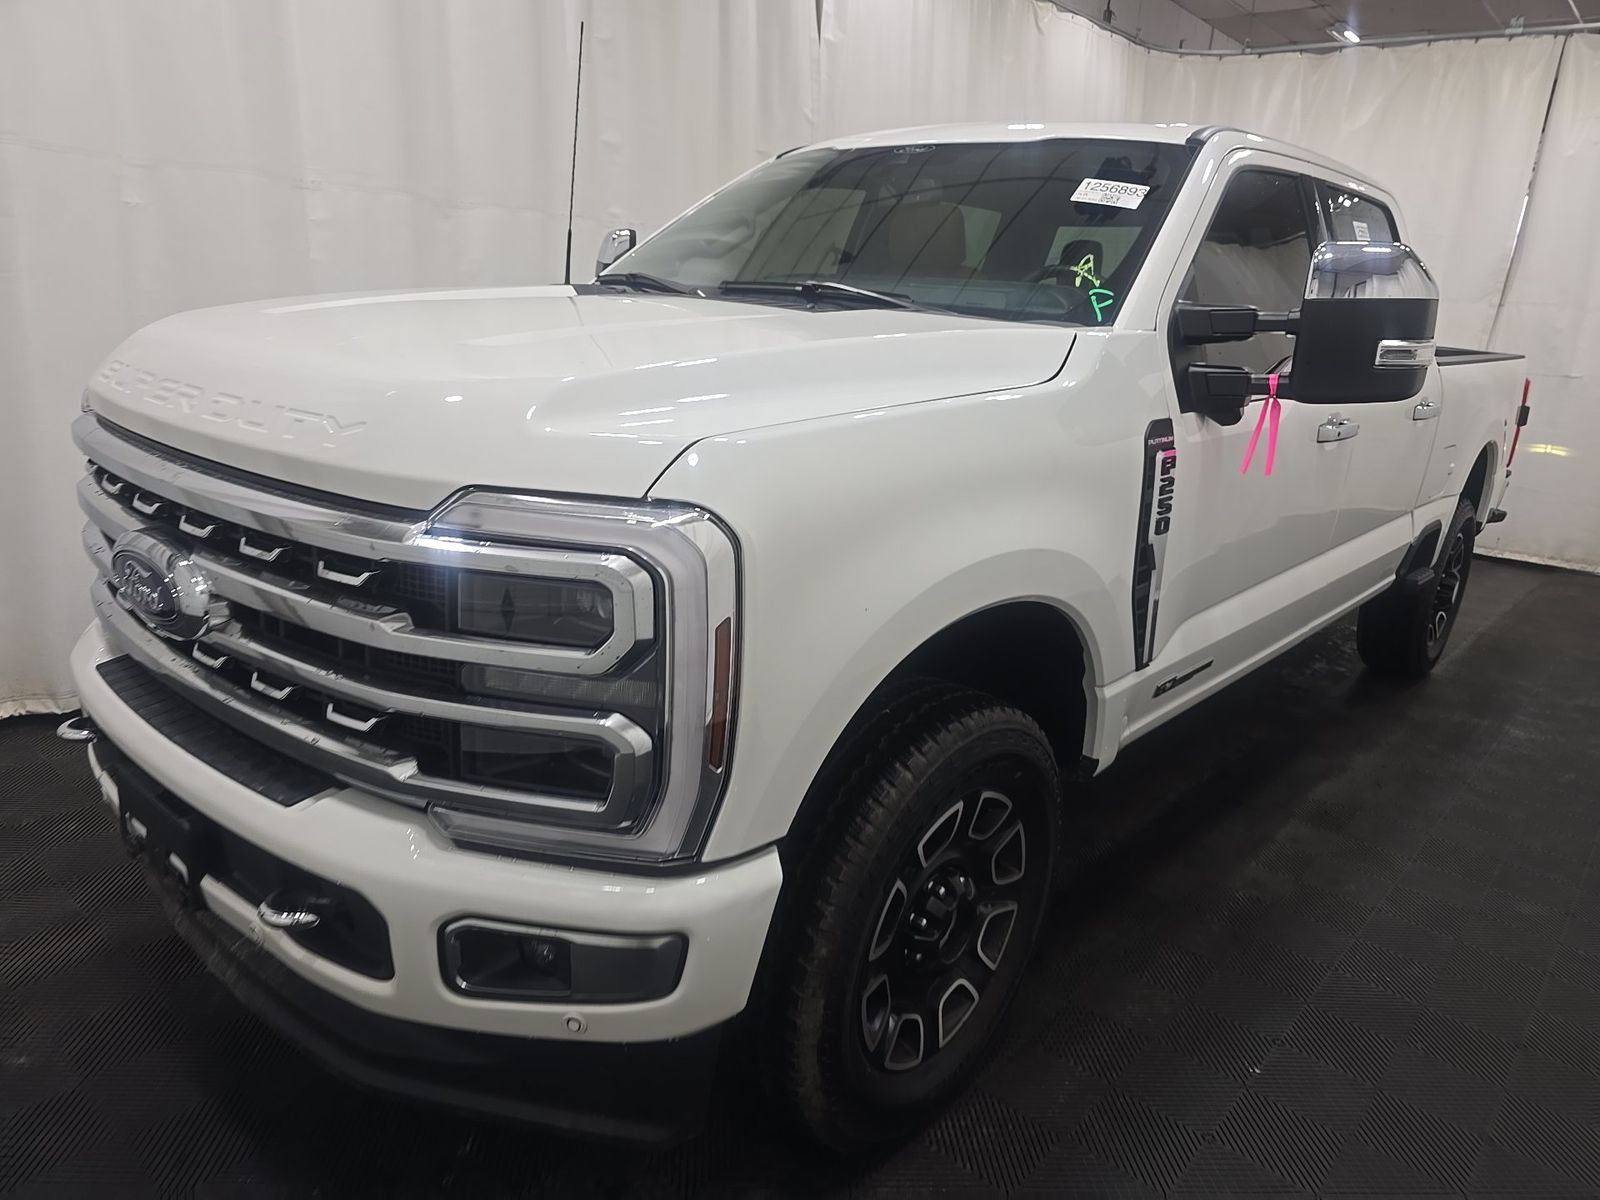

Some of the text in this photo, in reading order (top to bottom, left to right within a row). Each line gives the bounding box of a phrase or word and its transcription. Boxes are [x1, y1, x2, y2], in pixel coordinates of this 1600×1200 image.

[1084, 181, 1147, 197] 1256893
[200, 391, 368, 448] DUTY
[1154, 455, 1177, 536] F250
